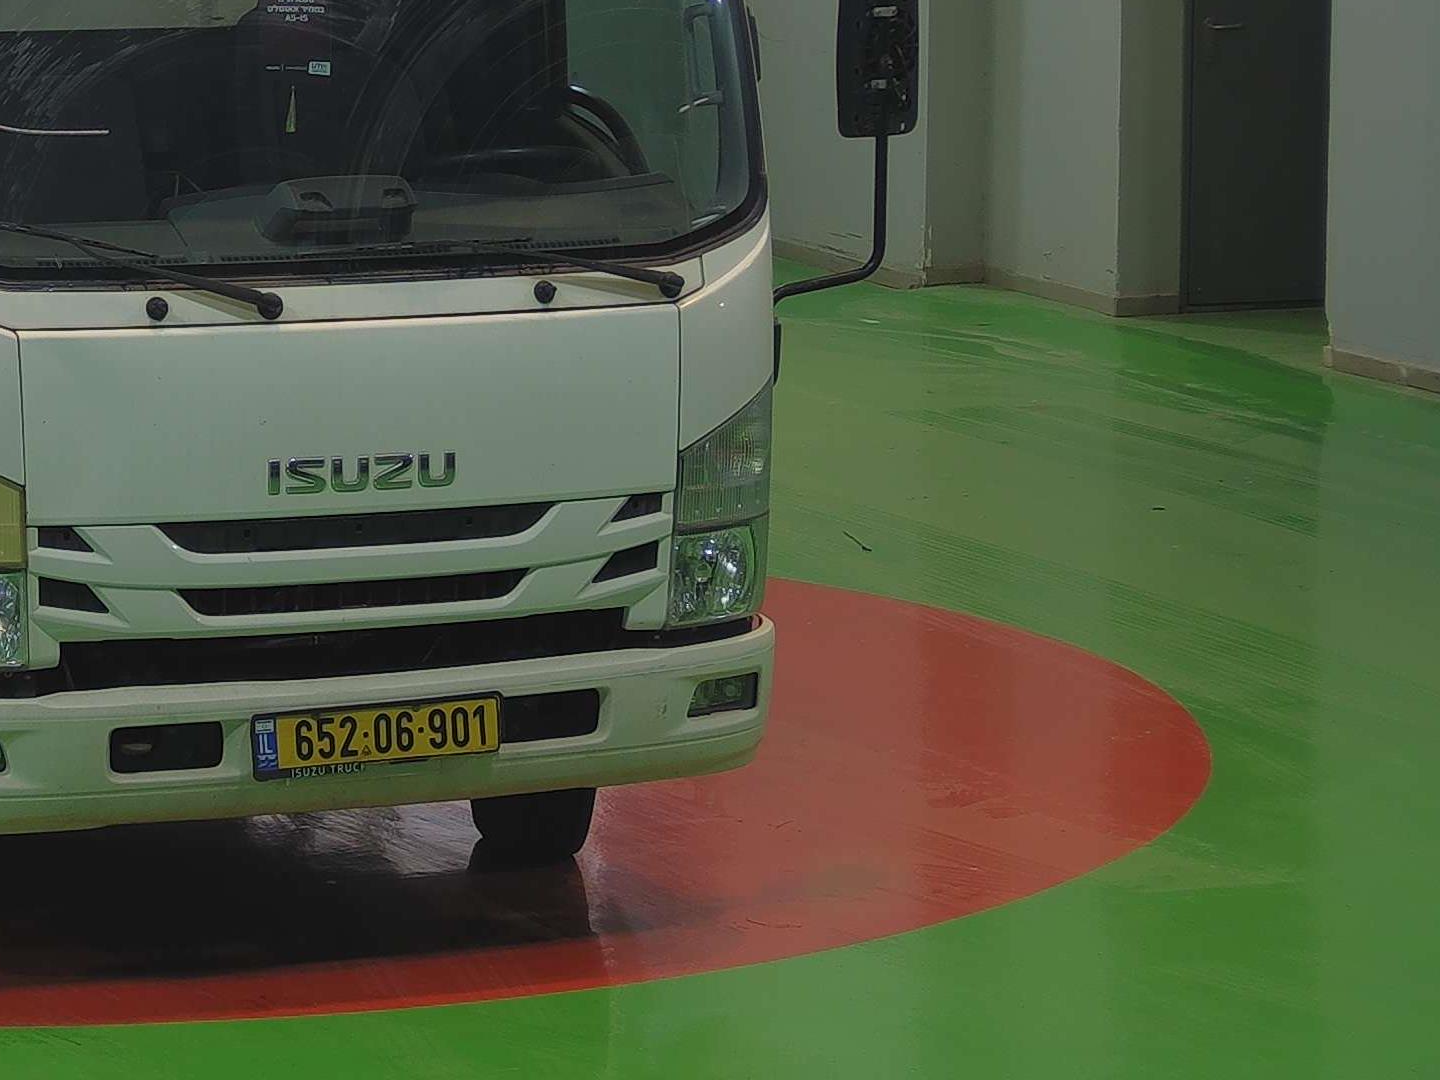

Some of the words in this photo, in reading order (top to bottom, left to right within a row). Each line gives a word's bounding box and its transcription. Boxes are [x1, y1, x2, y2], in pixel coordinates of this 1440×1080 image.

[266, 450, 457, 496] ISUZU
[258, 733, 273, 754] IL
[291, 766, 326, 779] ISUZU
